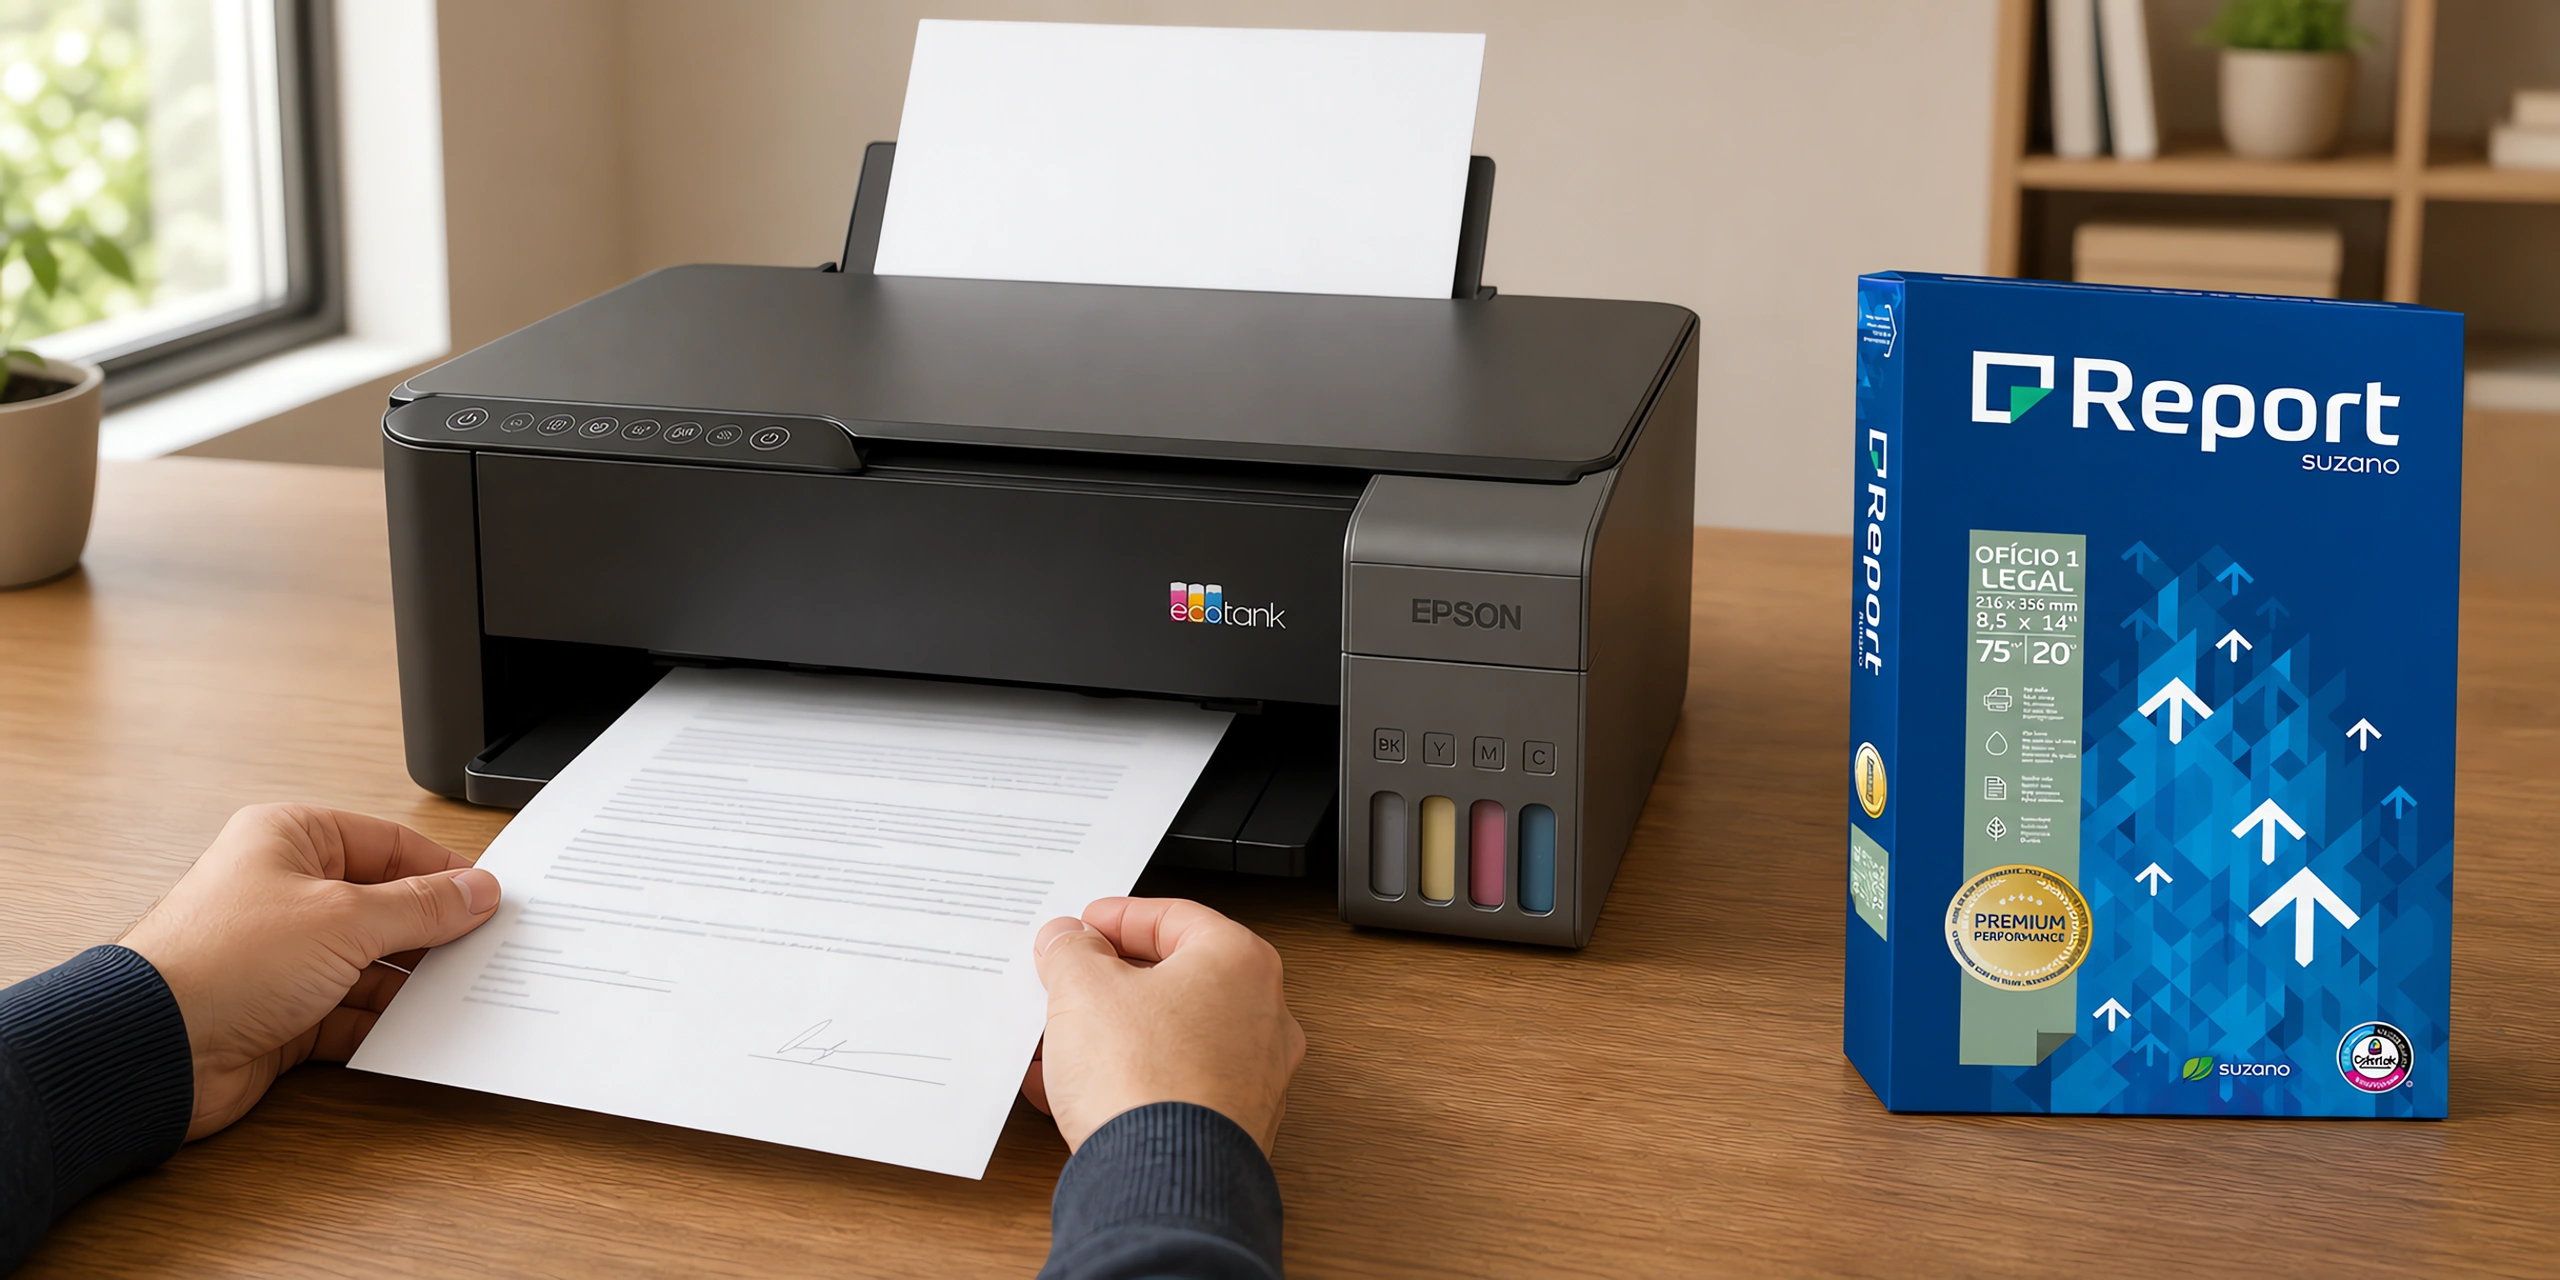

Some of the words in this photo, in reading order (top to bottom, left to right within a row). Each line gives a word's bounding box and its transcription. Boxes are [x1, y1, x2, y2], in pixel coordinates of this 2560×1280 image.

[2072, 357, 2400, 452] Report
[2302, 454, 2400, 475] suzano
[1975, 542, 2060, 566] OFÍCIO
[2066, 550, 2079, 567] 1
[1863, 483, 1888, 676] Report
[1982, 568, 2074, 592] LEGAL
[1976, 596, 2004, 609] 216
[2006, 600, 2016, 610] x
[2018, 597, 2045, 611] 356
[2049, 602, 2078, 612] mm
[1170, 601, 1287, 630] ecotank
[1412, 598, 1522, 631] EPSON
[1976, 612, 2007, 631] 8,5
[2019, 617, 2031, 630] x
[1378, 737, 1400, 754] BK
[1433, 741, 1447, 758] Y
[1481, 745, 1497, 762] M
[1531, 749, 1546, 766] C
[1975, 913, 2066, 930] PREMIUM
[2219, 1063, 2291, 1077] suzano
